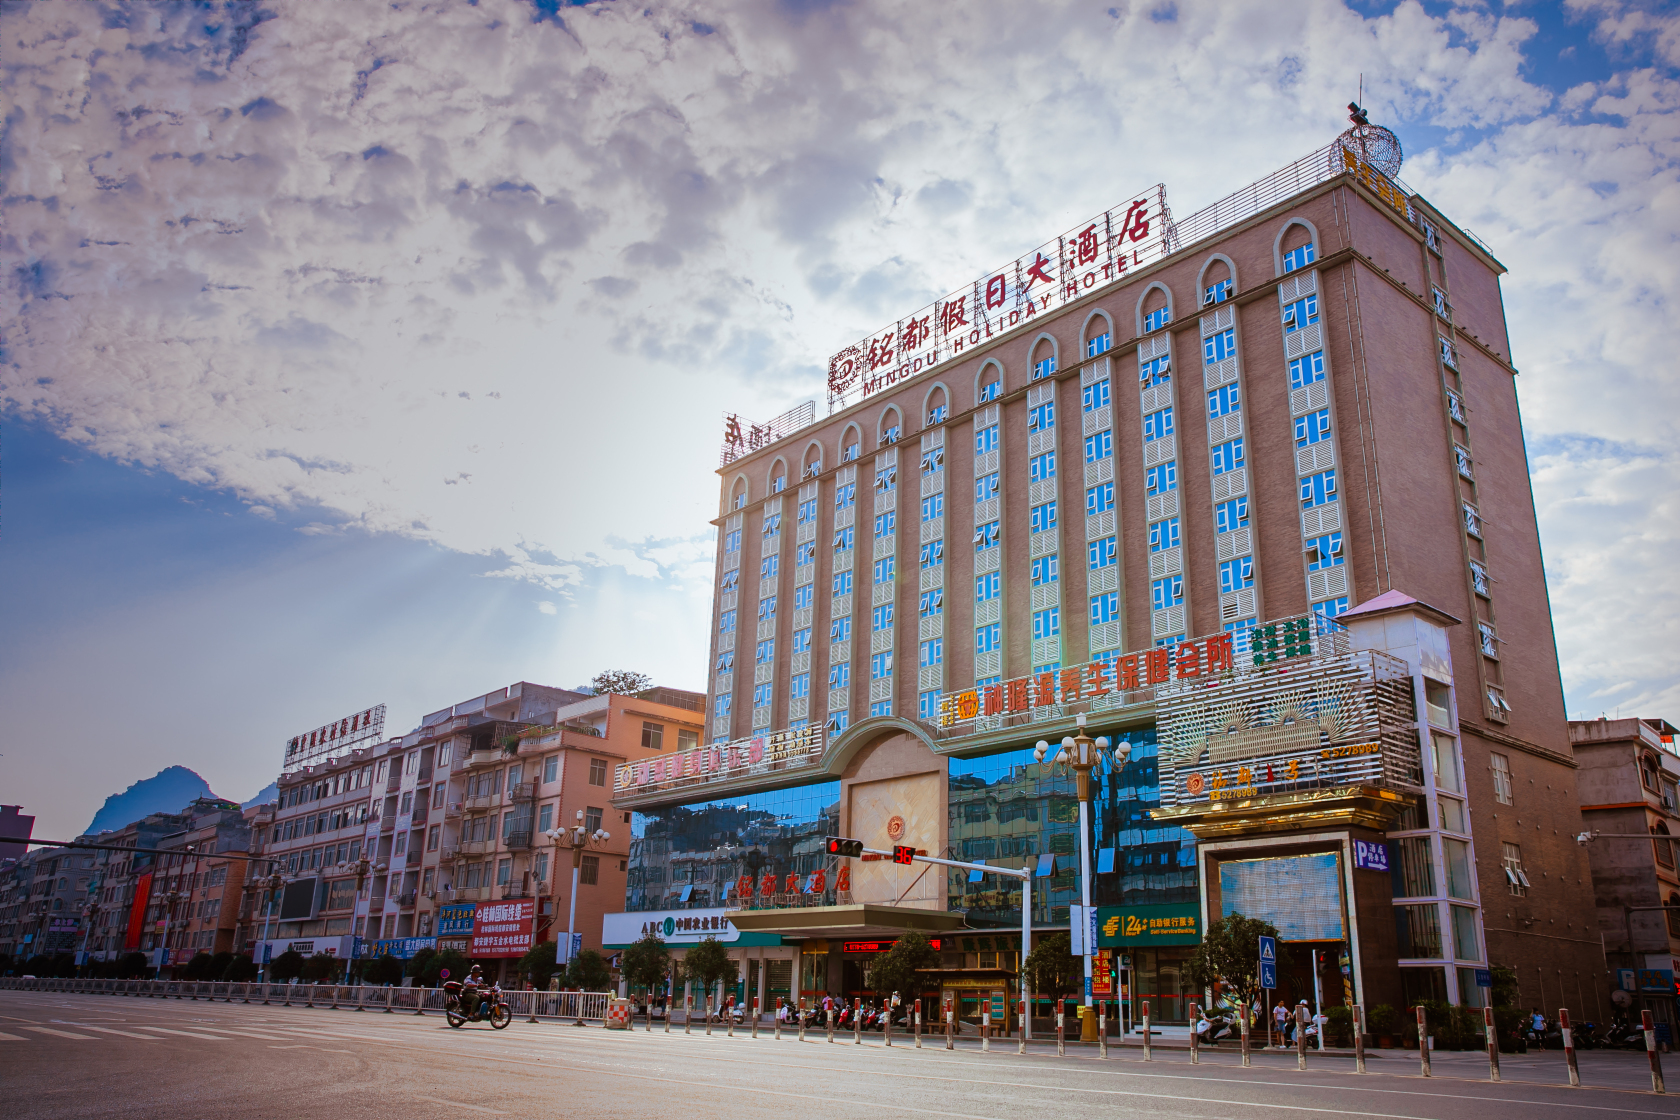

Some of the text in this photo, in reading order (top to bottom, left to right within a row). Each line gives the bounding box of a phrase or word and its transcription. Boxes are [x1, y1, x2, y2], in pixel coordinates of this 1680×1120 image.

[867, 198, 1150, 371] 铭都假日大酒店
[863, 250, 1144, 397] MINGDU HOLIDAY HOTEL
[1332, 743, 1380, 768] 5278989
[1231, 787, 1258, 800] 5278989
[896, 846, 912, 865] 36
[1357, 841, 1367, 866] P
[737, 866, 851, 898] 铭都大酒店
[641, 921, 664, 934] ABC
[676, 916, 729, 931] 中国农业银行
[1126, 915, 1142, 935] 24
[1149, 916, 1196, 928] 自助银行服务
